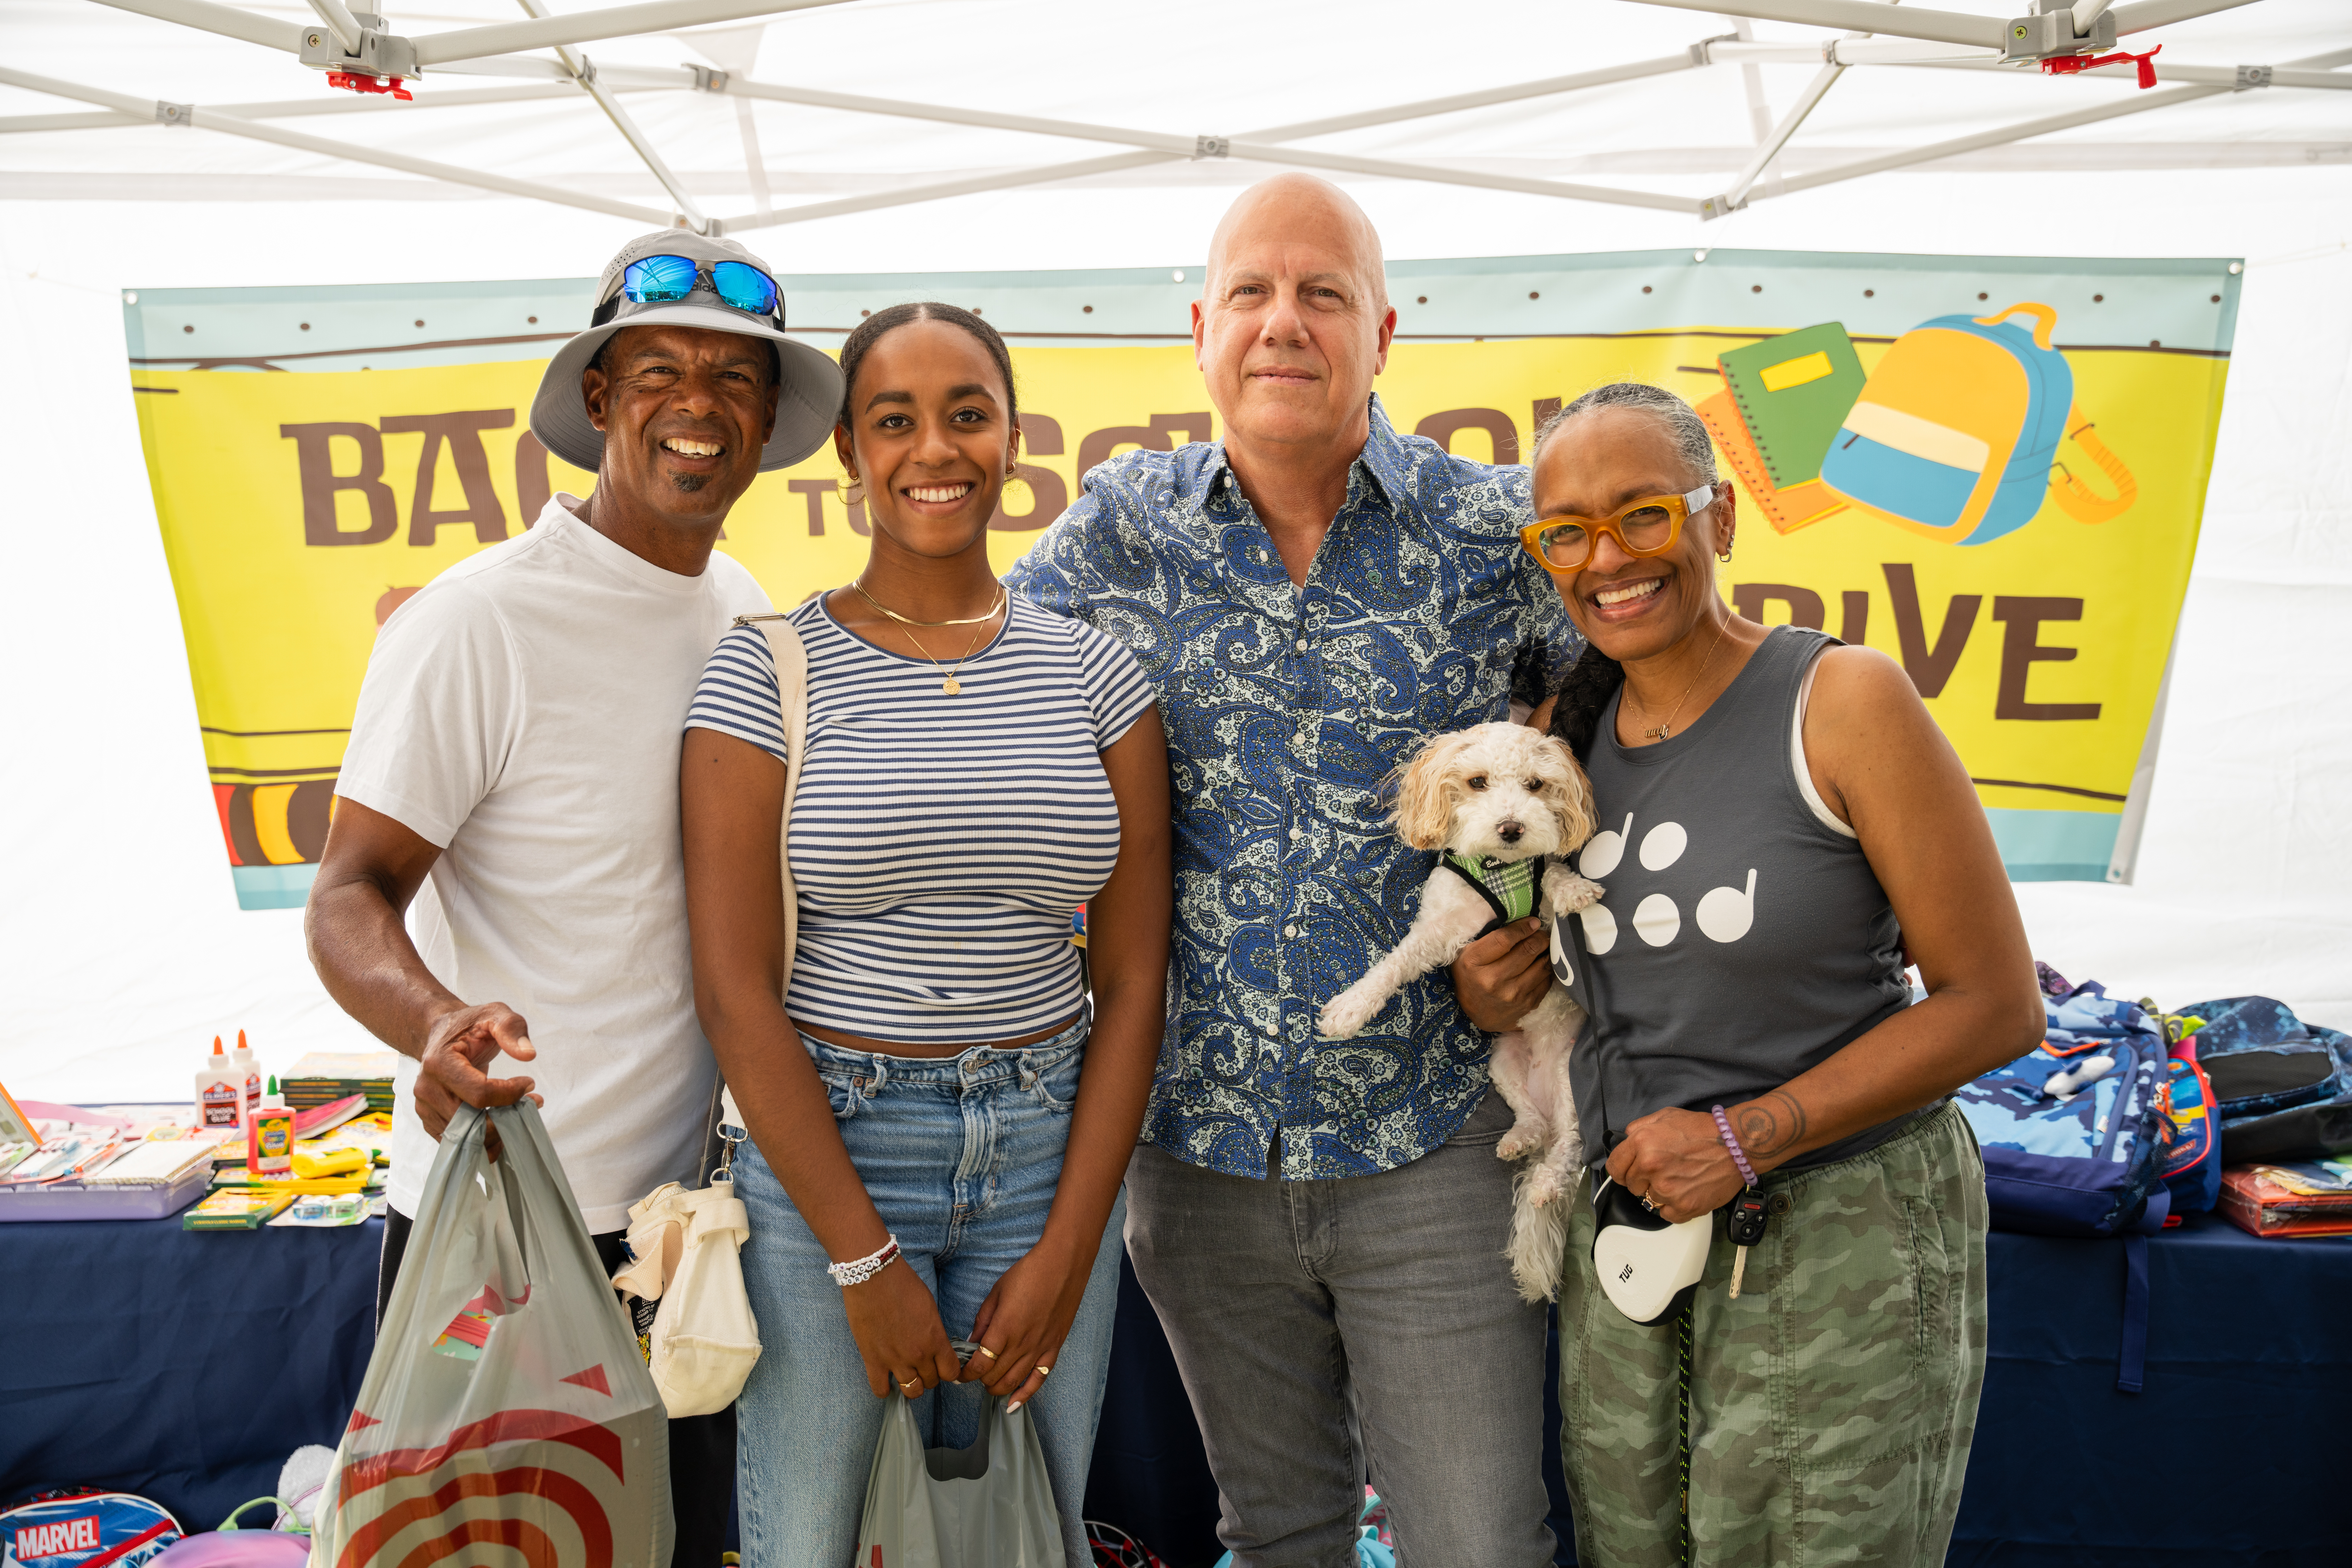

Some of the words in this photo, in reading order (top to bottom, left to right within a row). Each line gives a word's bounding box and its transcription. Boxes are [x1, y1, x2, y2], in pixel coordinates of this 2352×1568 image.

[691, 282, 718, 294] dida
[1486, 858, 1500, 868] Bark
[205, 1107, 236, 1116] SCHOOL
[211, 1114, 231, 1123] GLUE
[1619, 1264, 1633, 1283] TUG
[18, 1518, 98, 1558] MARVEL
